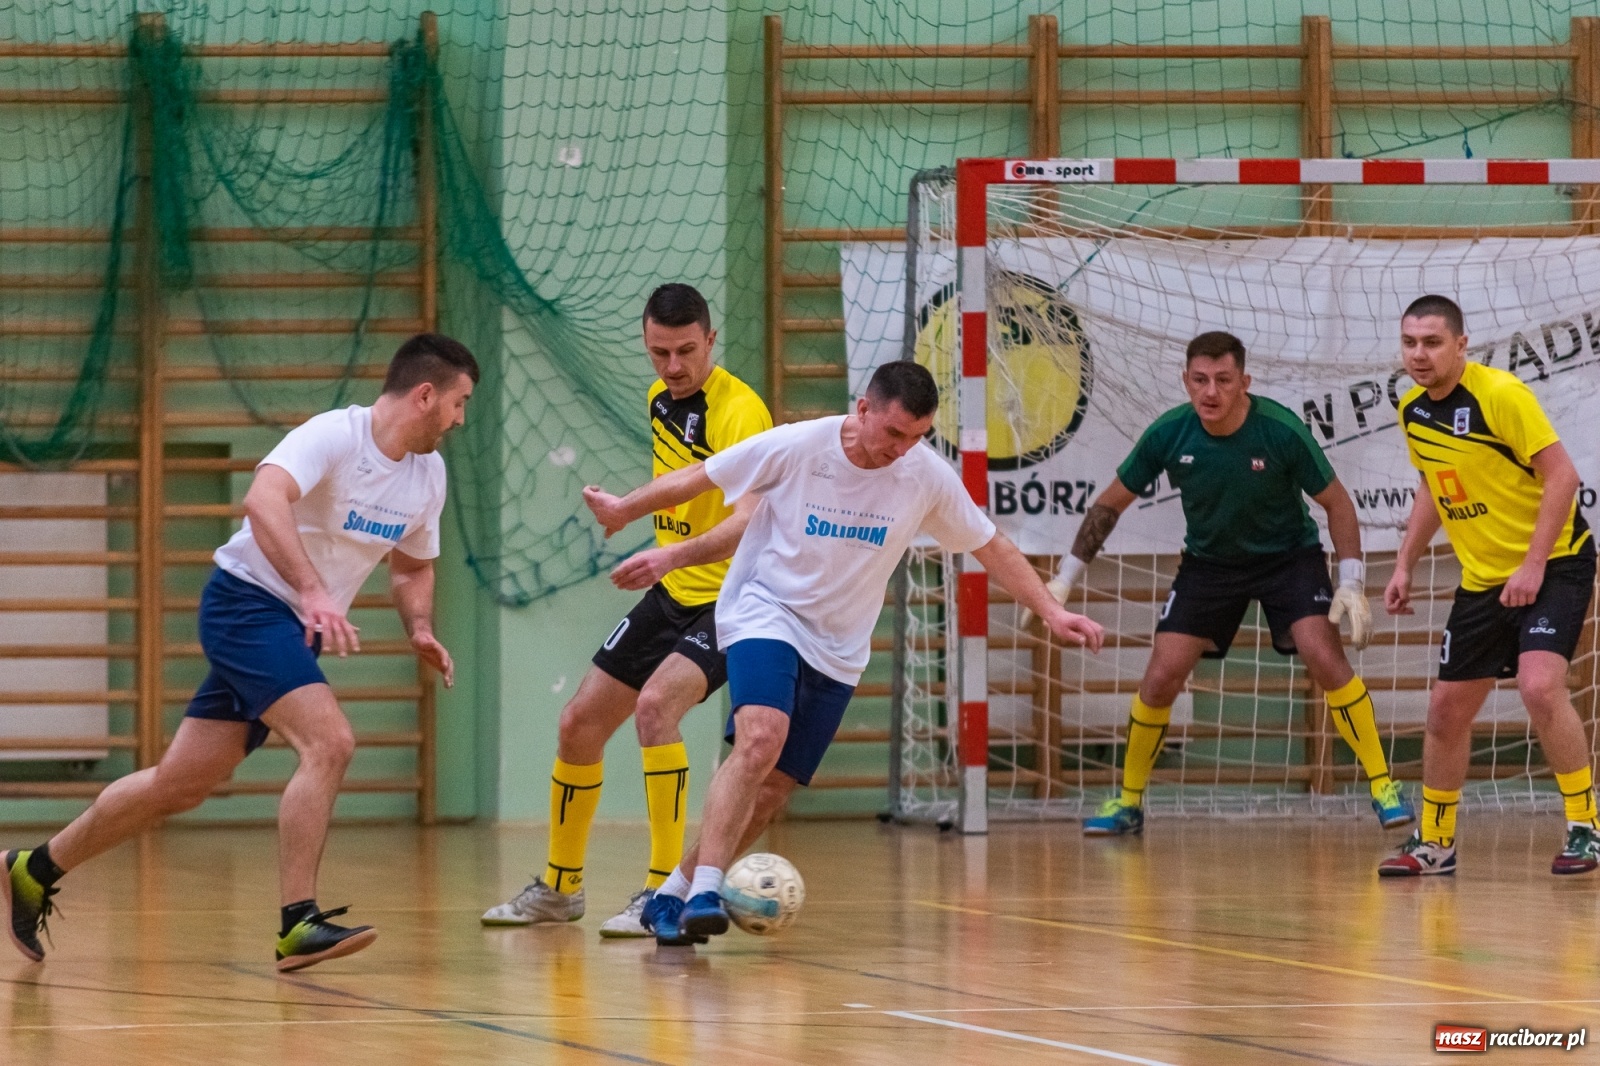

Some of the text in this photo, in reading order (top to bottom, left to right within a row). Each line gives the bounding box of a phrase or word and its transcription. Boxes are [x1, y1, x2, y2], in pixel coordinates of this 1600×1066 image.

[987, 472, 1096, 516] BÓRZ
[343, 509, 407, 542] SOLIDUM
[653, 514, 691, 536] ILBUD
[805, 513, 888, 547] SOLIDUM
